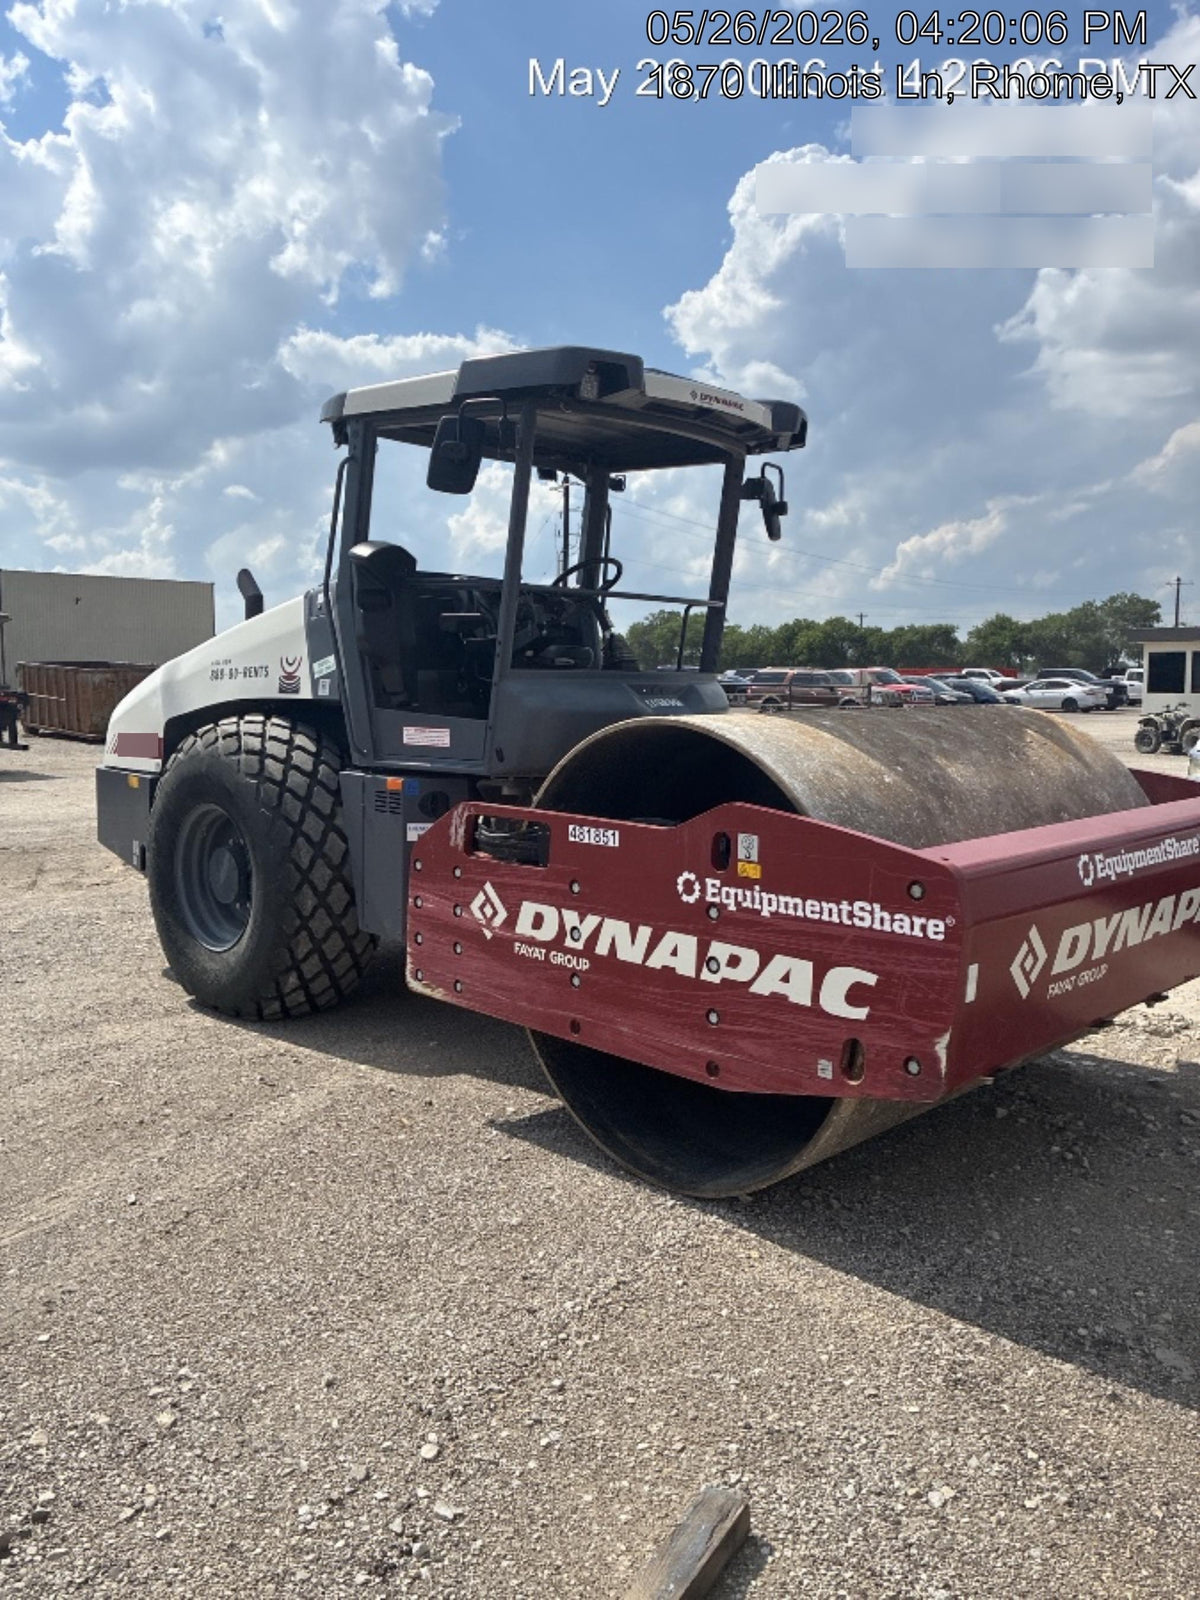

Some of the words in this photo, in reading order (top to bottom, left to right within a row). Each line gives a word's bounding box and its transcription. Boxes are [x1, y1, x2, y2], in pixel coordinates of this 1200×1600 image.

[570, 826, 616, 846] 481851
[1095, 837, 1200, 881] EquipmentShare
[1050, 887, 1200, 977] DYNAP
[514, 941, 548, 962] FAYAT
[549, 951, 591, 971] GROUP
[514, 901, 879, 1020] DYNAPAC
[1076, 962, 1110, 987] GROUP
